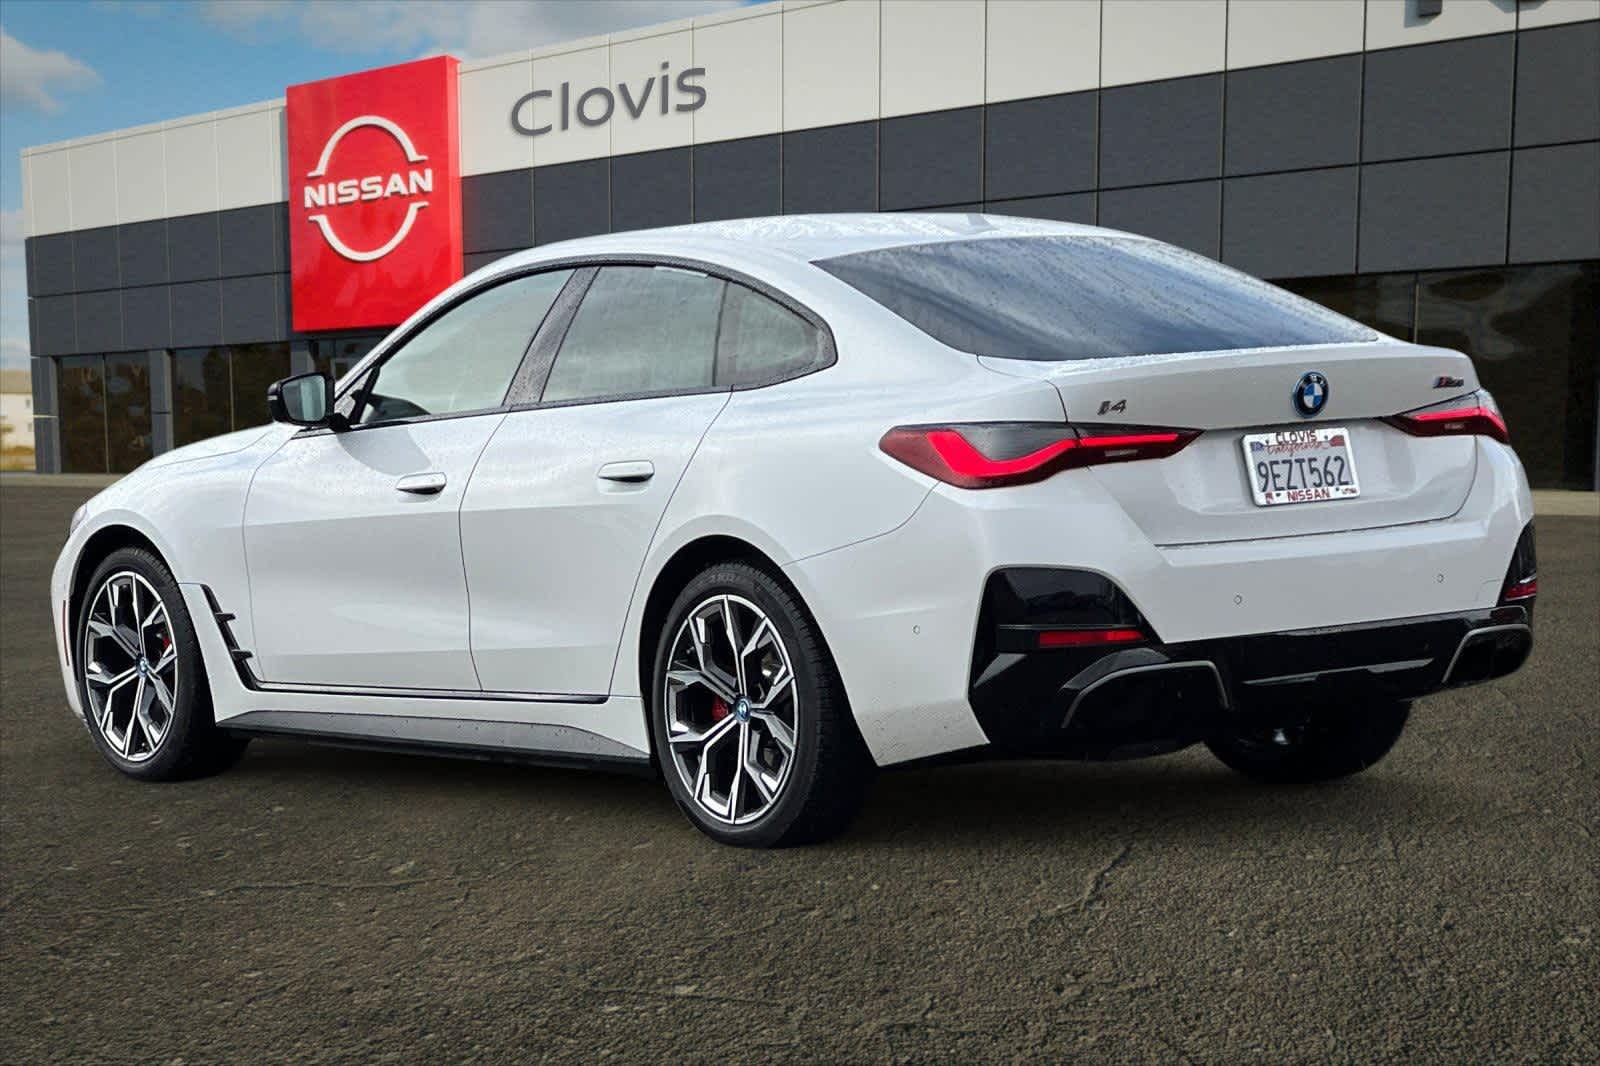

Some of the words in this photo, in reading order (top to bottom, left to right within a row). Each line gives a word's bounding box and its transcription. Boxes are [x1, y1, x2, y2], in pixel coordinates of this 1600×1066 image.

[303, 168, 433, 209] NISSAN
[1275, 430, 1318, 444] CLOVIS
[1257, 455, 1350, 492] 9EZT562
[1287, 487, 1331, 502] NISSAN
